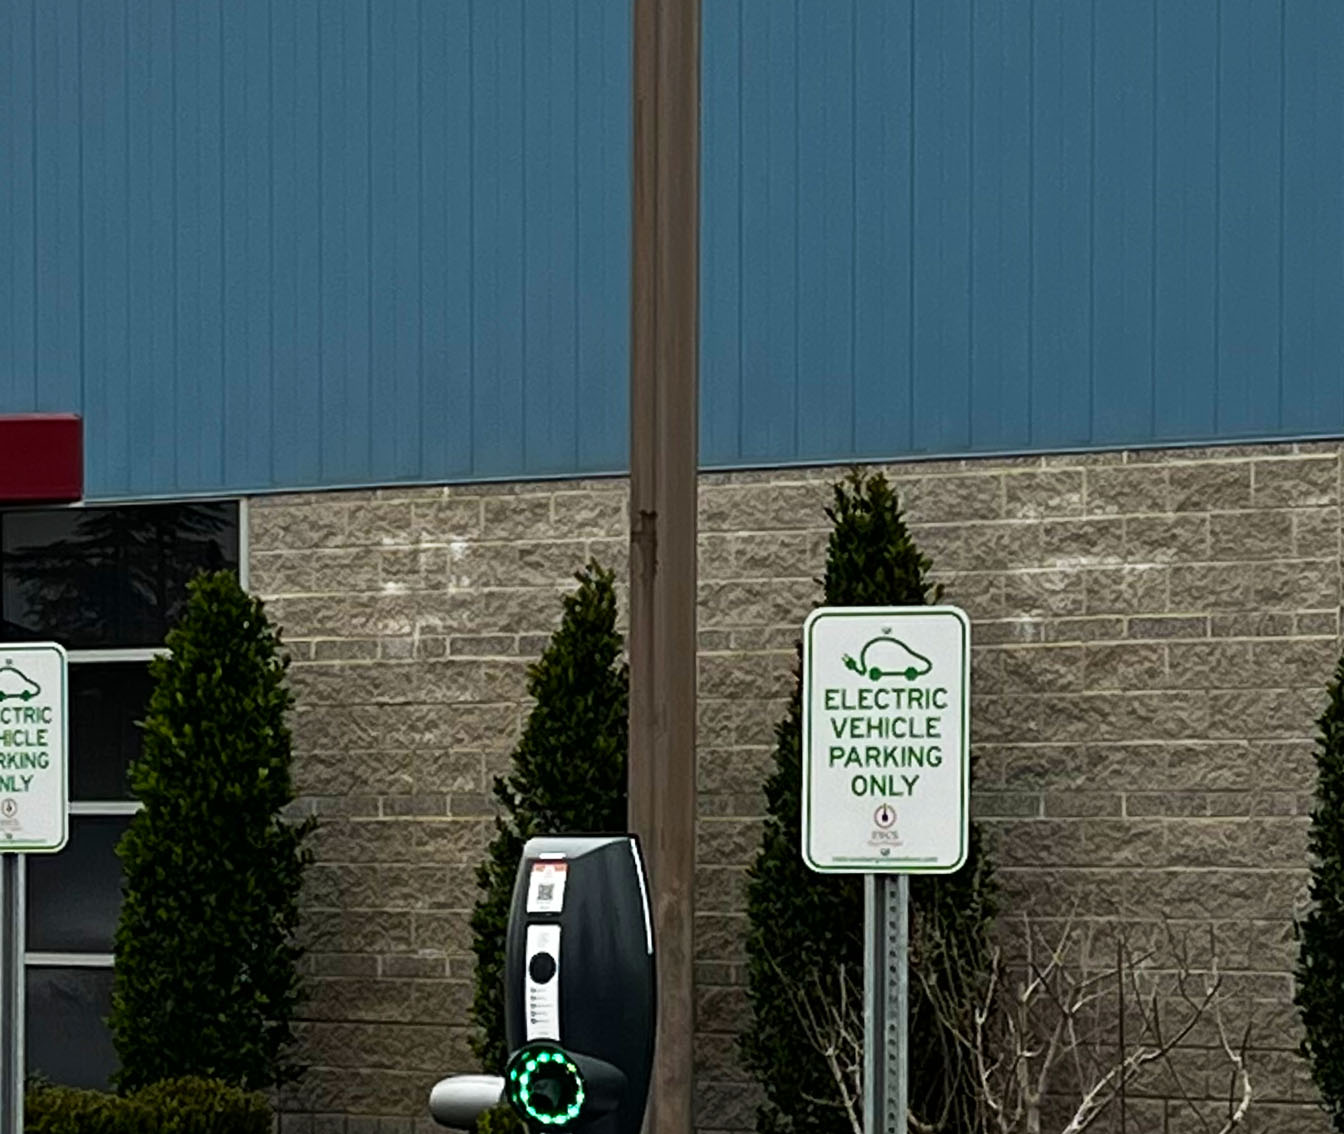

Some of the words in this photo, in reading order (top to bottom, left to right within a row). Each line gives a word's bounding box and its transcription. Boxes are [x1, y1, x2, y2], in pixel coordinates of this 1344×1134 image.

[825, 688, 948, 710] ELECTRIC
[831, 717, 941, 739] VEHICLE
[829, 746, 943, 768] PARKING
[851, 775, 920, 796] ONLY
